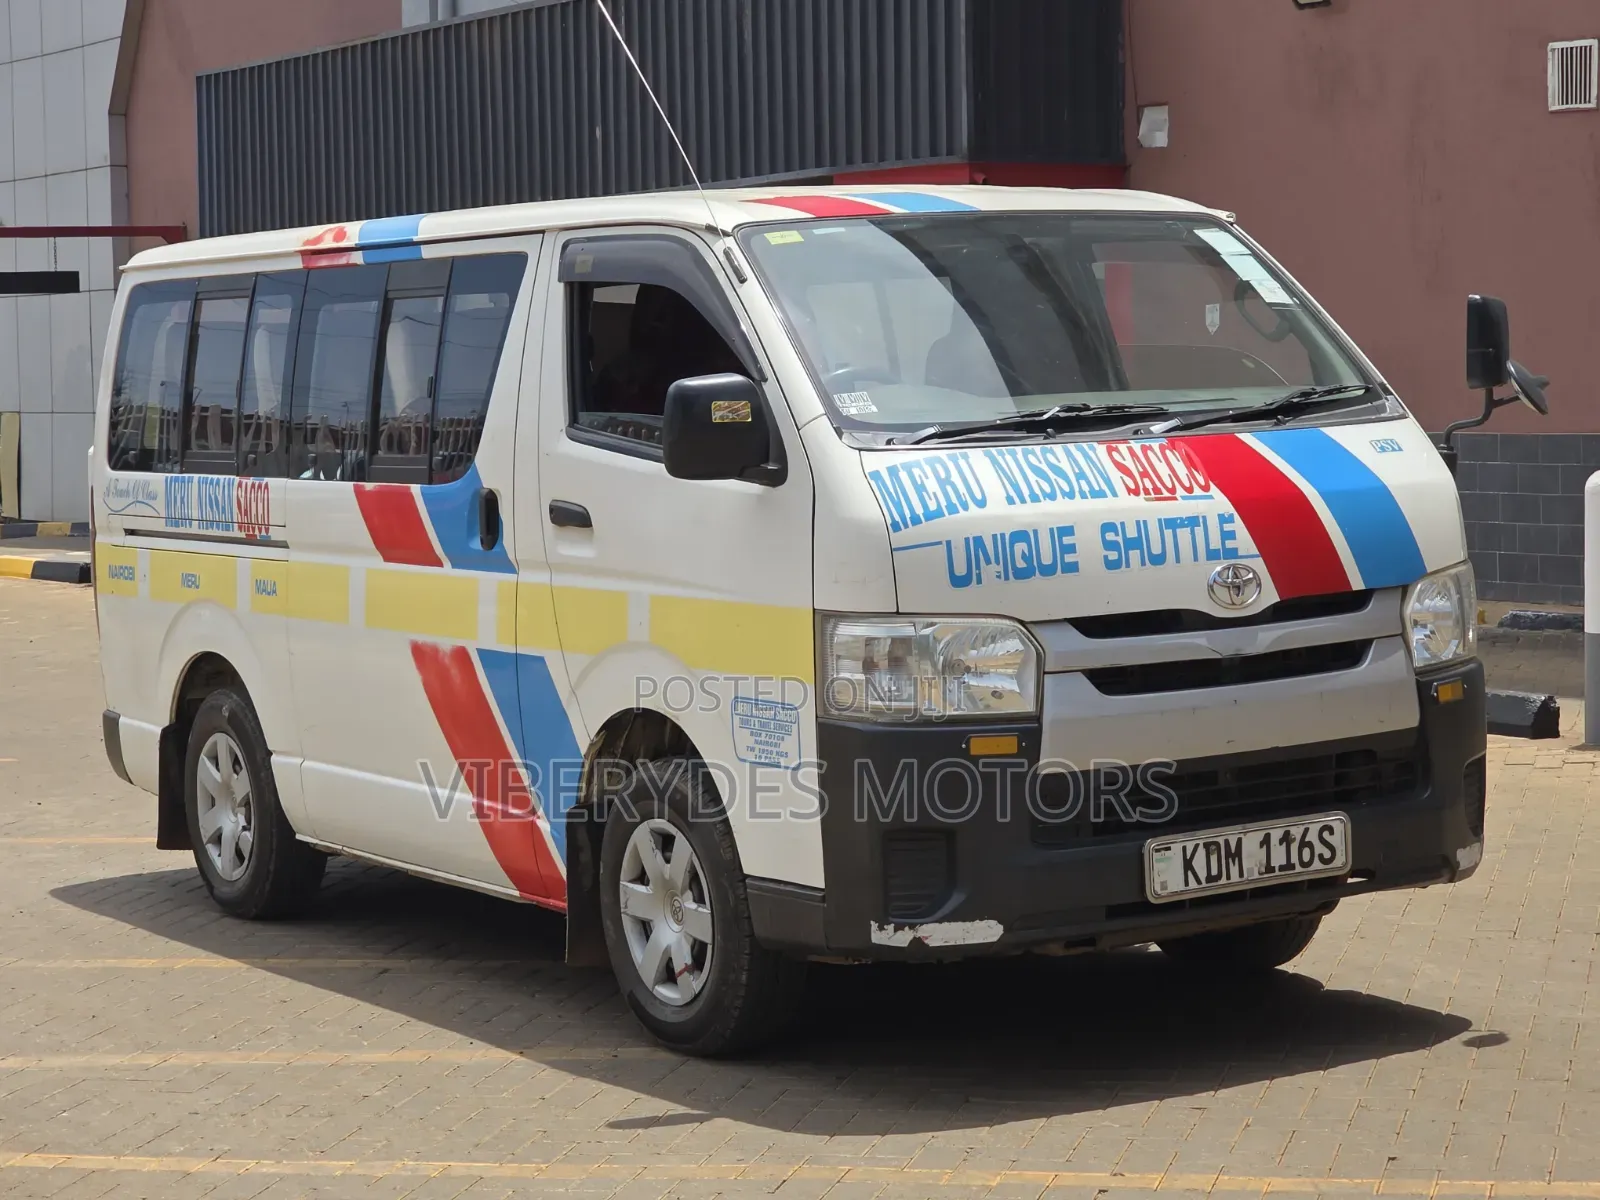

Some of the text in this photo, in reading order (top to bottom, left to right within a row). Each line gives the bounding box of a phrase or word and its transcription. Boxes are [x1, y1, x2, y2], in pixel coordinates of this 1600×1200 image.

[1370, 439, 1400, 452] PSV
[141, 479, 158, 501] Class
[868, 440, 1212, 534] MERU NISSAN SACCO
[164, 475, 270, 535] MERU NISSAN SACCO
[945, 512, 1240, 589] UNIQUE SHUTTLE
[108, 564, 136, 582] NAIROBI
[180, 572, 201, 590] MERU
[735, 700, 752, 716] MERU
[775, 706, 797, 723] SACCO
[773, 721, 793, 733] SERVICES
[746, 745, 756, 753] TW
[775, 750, 789, 758] KGS
[754, 739, 781, 748] NAIROBI
[1181, 823, 1337, 887] KDM 116S
